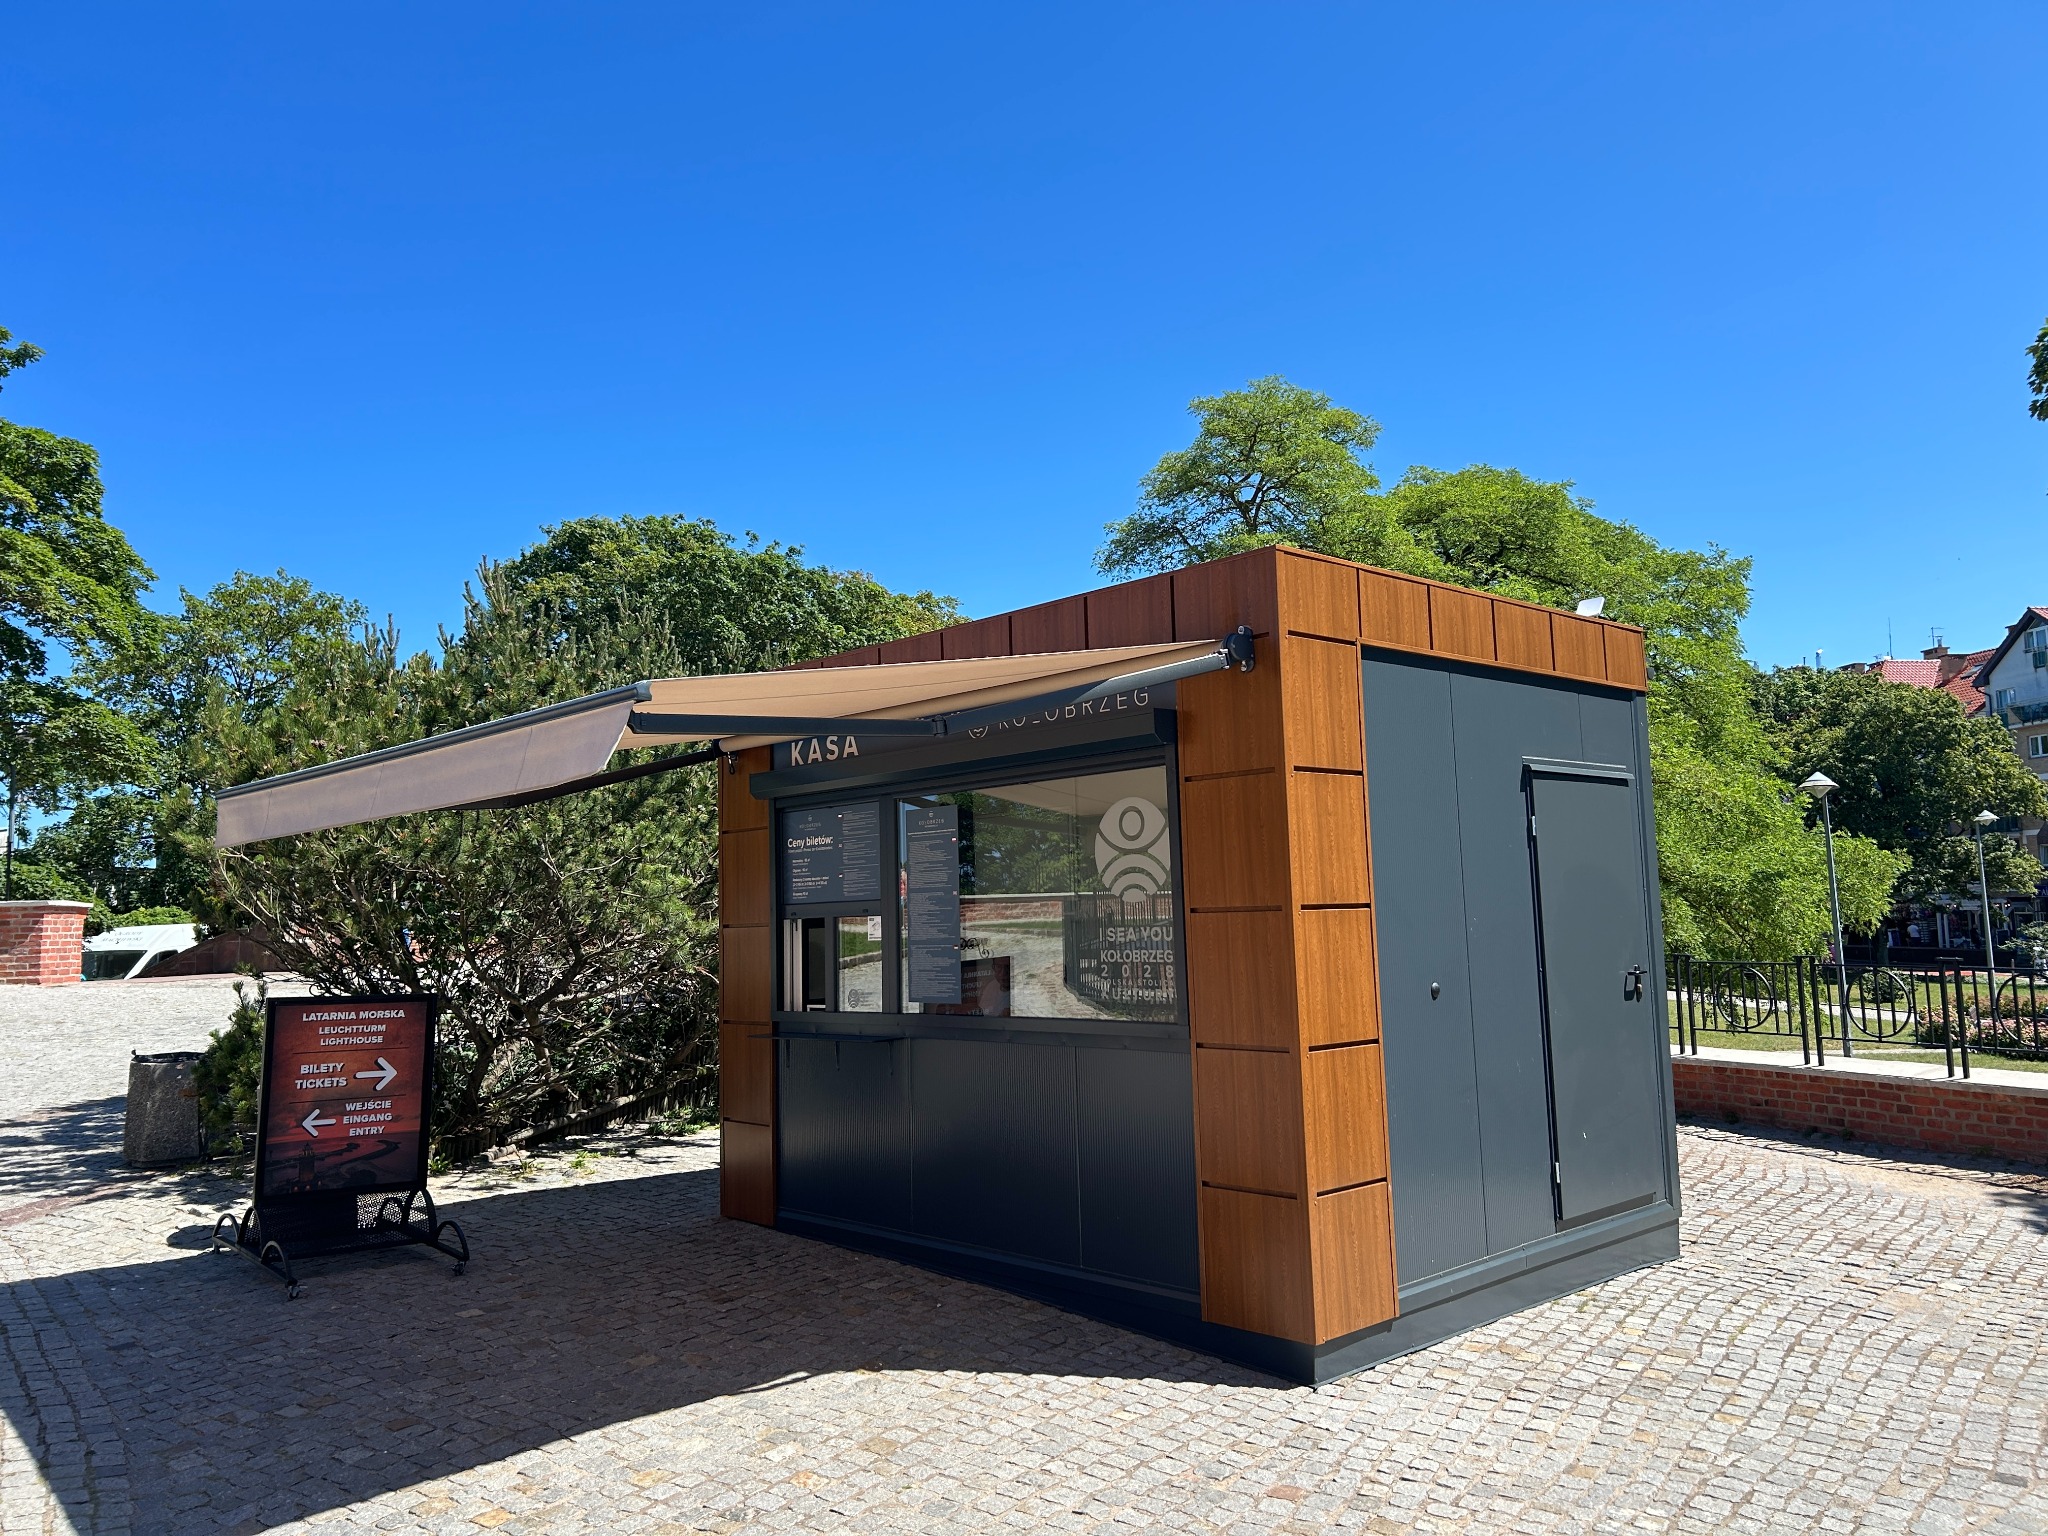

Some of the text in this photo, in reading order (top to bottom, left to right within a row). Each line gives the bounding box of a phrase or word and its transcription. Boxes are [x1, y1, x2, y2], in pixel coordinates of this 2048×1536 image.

[999, 687, 1150, 730] OOBRZEG
[791, 735, 859, 767] KASA
[787, 838, 805, 849] Ceny
[1107, 926, 1137, 942] SEA
[1141, 926, 1173, 942] YOU
[1100, 949, 1174, 963] KOŁOBRZEG
[302, 1009, 405, 1022] LATARNIA MORSKA
[318, 1024, 387, 1035] LEUCHTTURM
[320, 1035, 384, 1046] LIGHTHOUSE
[300, 1063, 344, 1074] BILETY
[295, 1077, 347, 1089] TICKETS
[345, 1100, 392, 1111] WEJŚCIE
[343, 1113, 392, 1124] EINGANG
[349, 1126, 385, 1136] ENTRY
